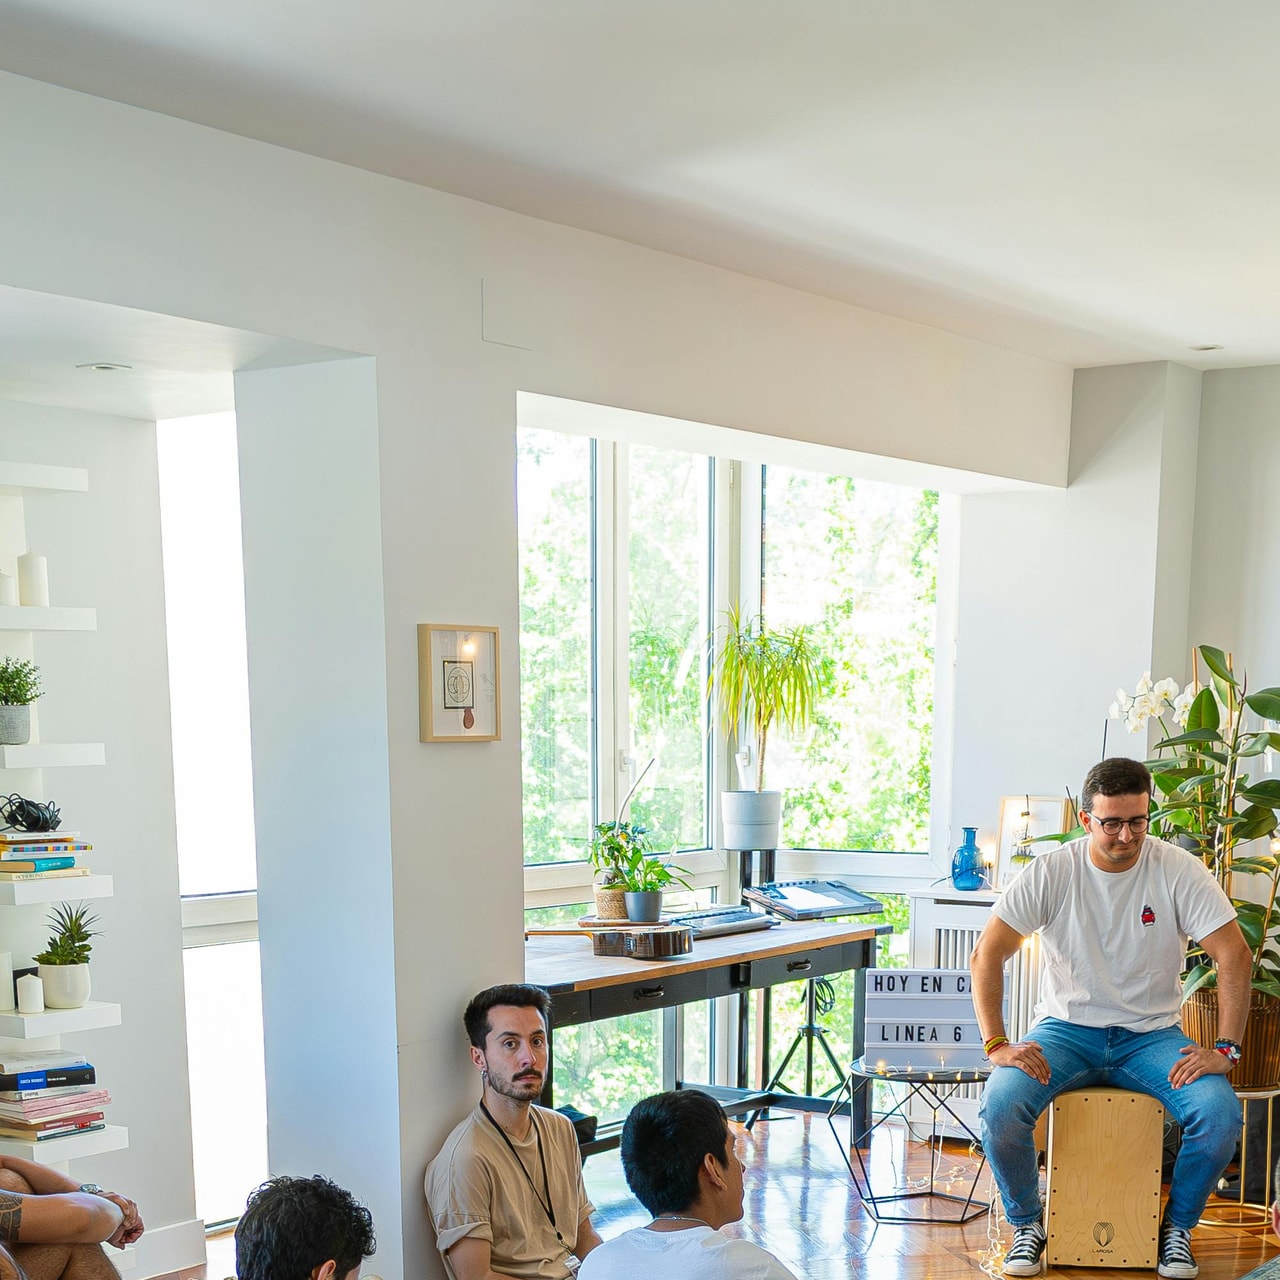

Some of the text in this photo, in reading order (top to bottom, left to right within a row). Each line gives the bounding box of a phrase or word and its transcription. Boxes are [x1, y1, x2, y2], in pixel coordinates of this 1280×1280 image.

[874, 975, 909, 992] HOY
[921, 976, 942, 993] EN
[881, 1025, 962, 1042] LINEA 6
